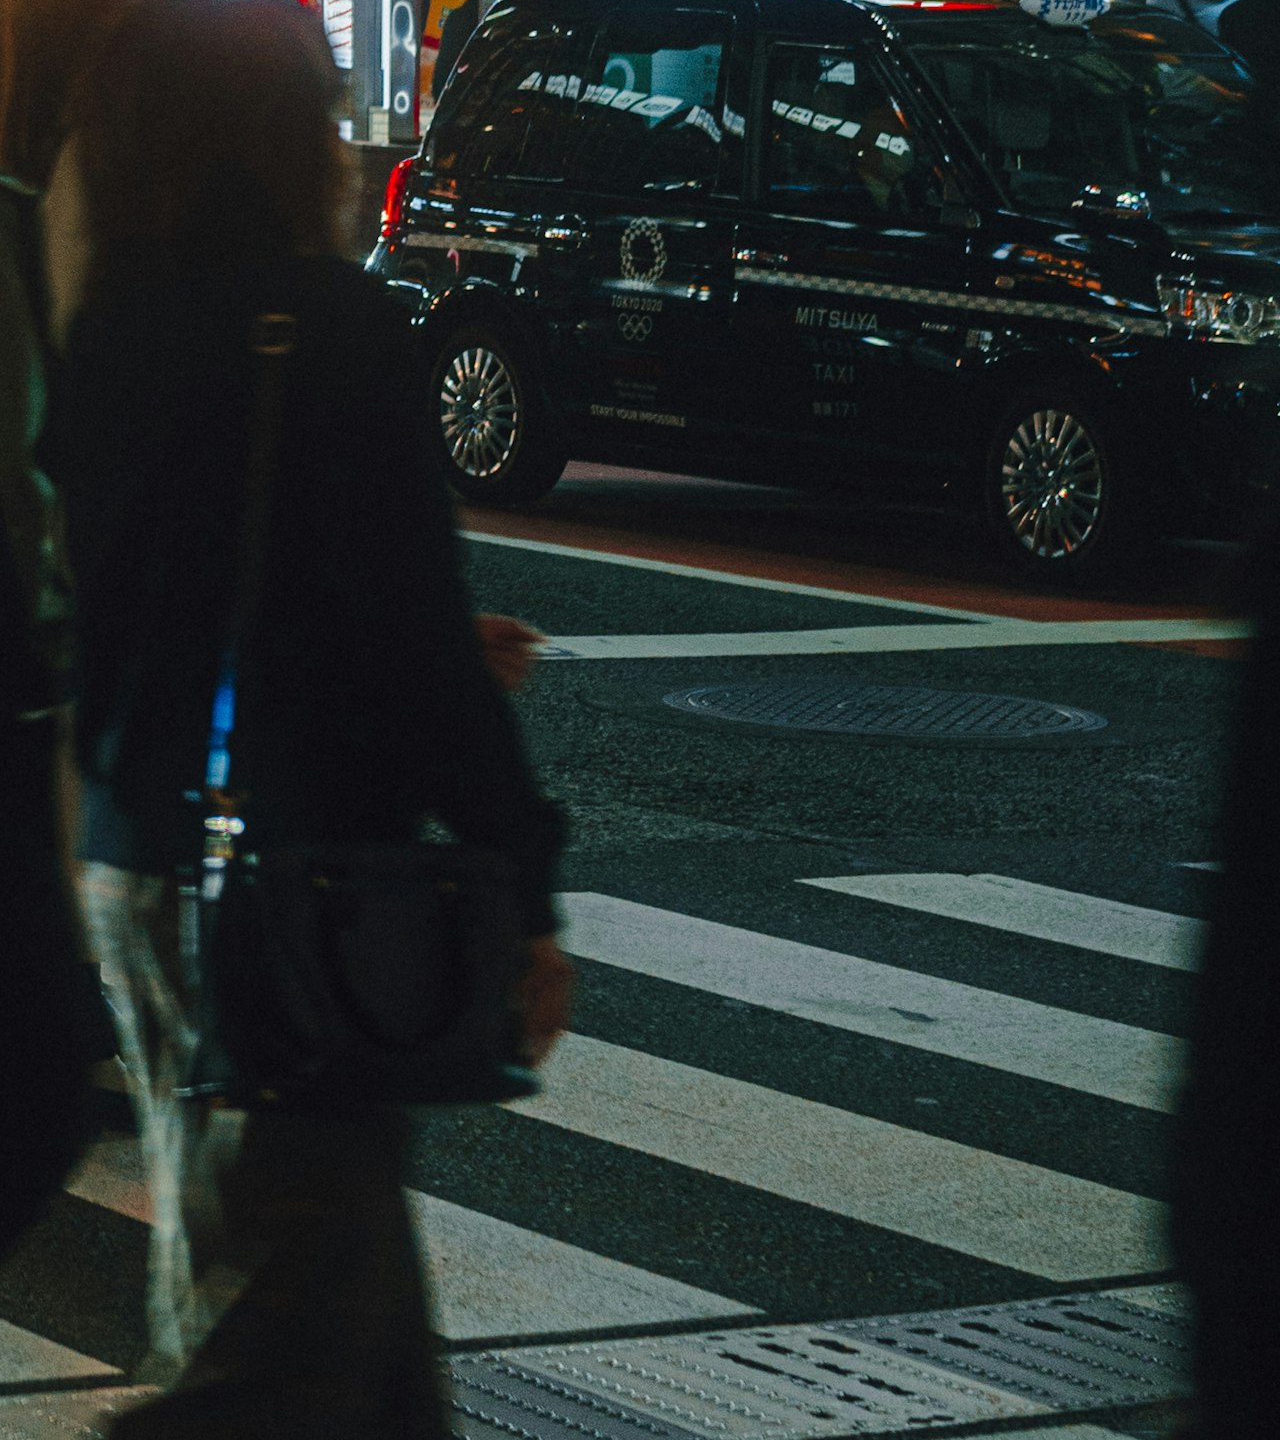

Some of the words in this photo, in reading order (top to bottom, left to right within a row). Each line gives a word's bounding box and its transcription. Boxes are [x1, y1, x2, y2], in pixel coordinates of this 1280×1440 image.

[639, 296, 663, 312] 2020
[795, 306, 880, 333] MITSUYA
[812, 363, 855, 385] TAXI
[590, 403, 616, 417] START
[616, 407, 638, 421] YOUR
